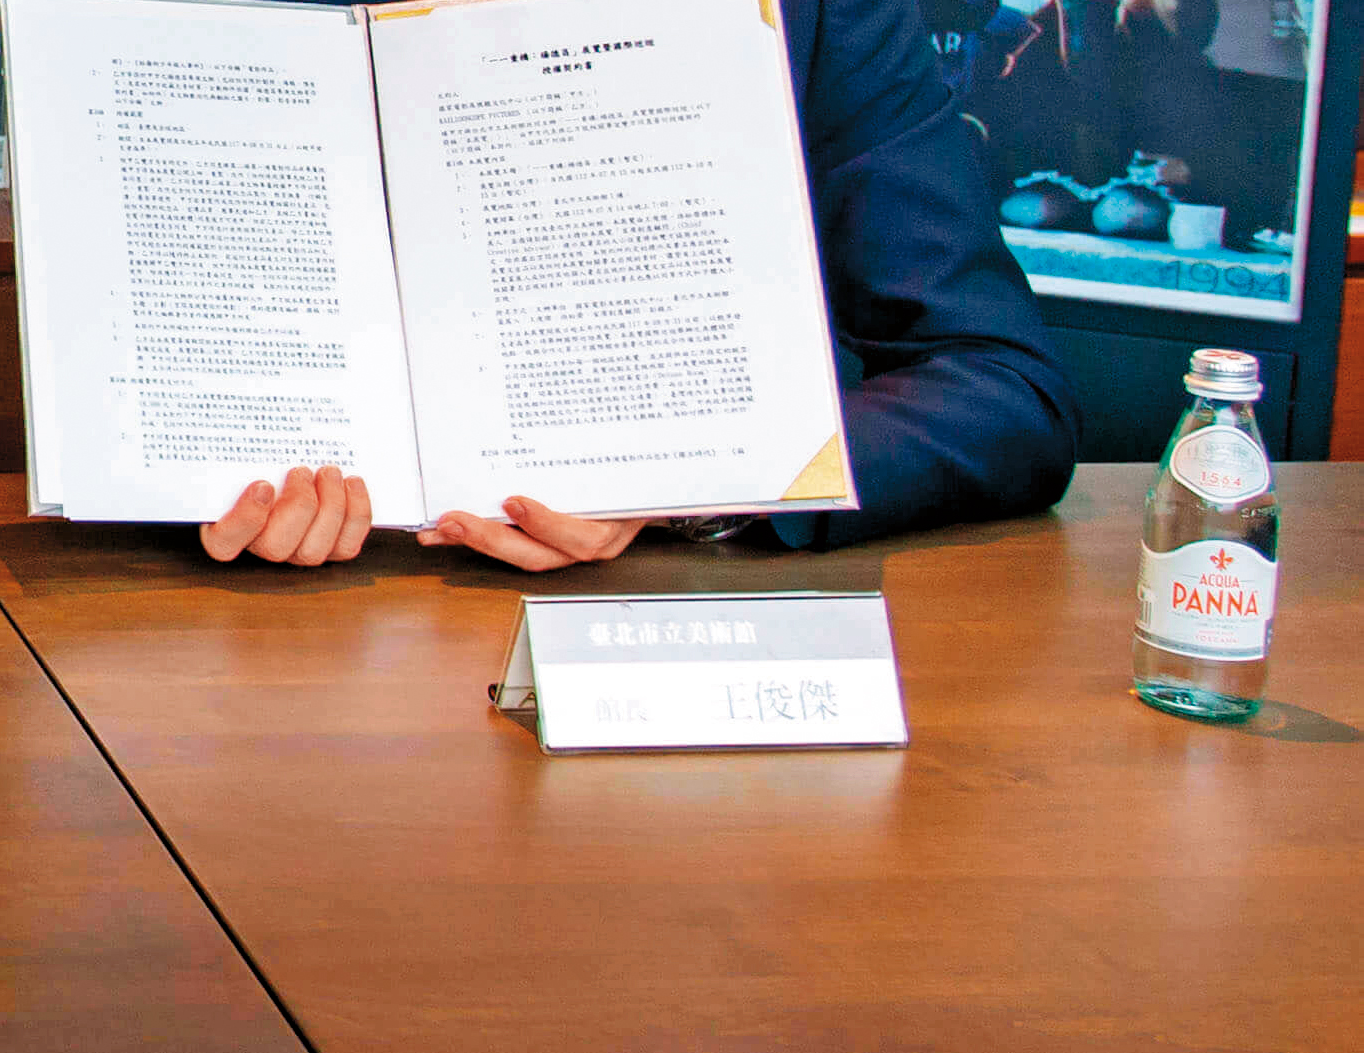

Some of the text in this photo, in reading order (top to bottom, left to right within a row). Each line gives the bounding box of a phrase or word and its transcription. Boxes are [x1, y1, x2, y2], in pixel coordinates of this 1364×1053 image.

[1199, 573, 1240, 588] ACQUA
[1172, 581, 1259, 616] PANNA
[723, 679, 839, 722] 王俊傑
